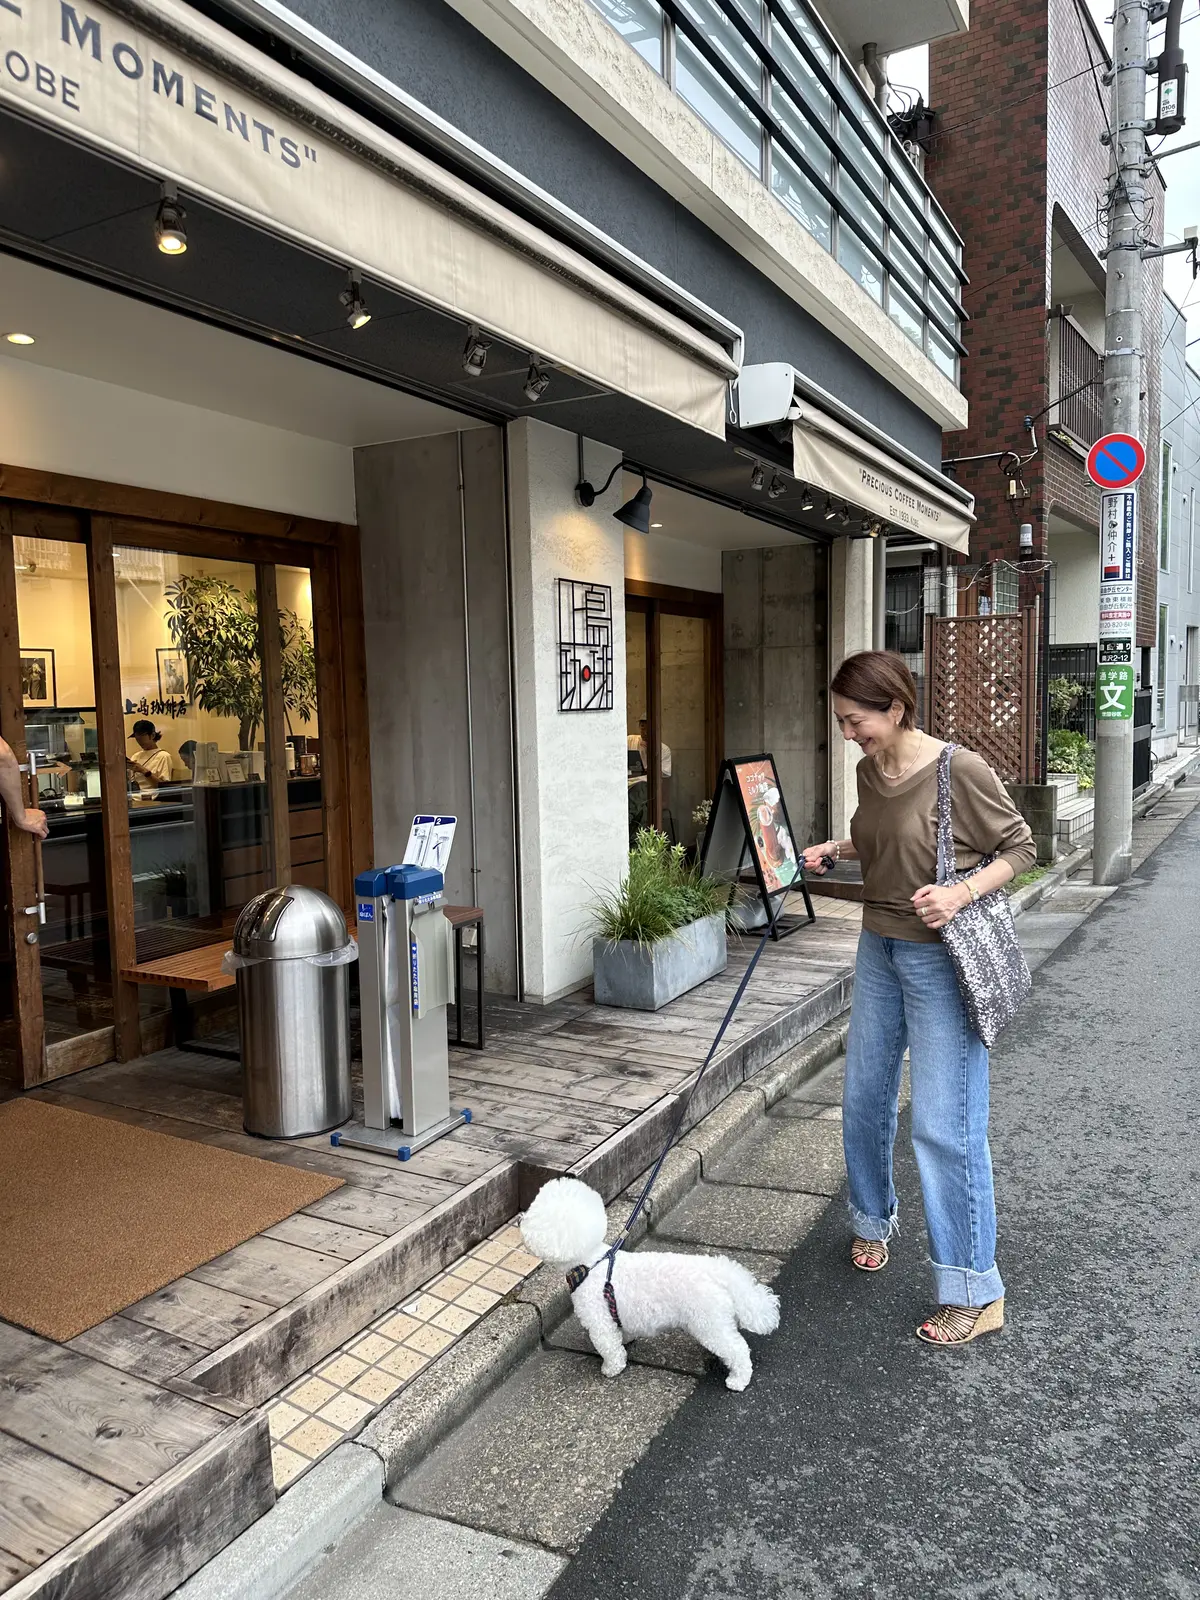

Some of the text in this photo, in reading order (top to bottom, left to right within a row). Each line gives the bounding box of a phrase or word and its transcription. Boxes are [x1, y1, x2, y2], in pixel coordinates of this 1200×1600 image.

[0, 50, 81, 112] OBE
[894, 488, 915, 509] COFFEE
[1099, 671, 1128, 681] 通学路
[123, 695, 187, 720] 上島珈琲店
